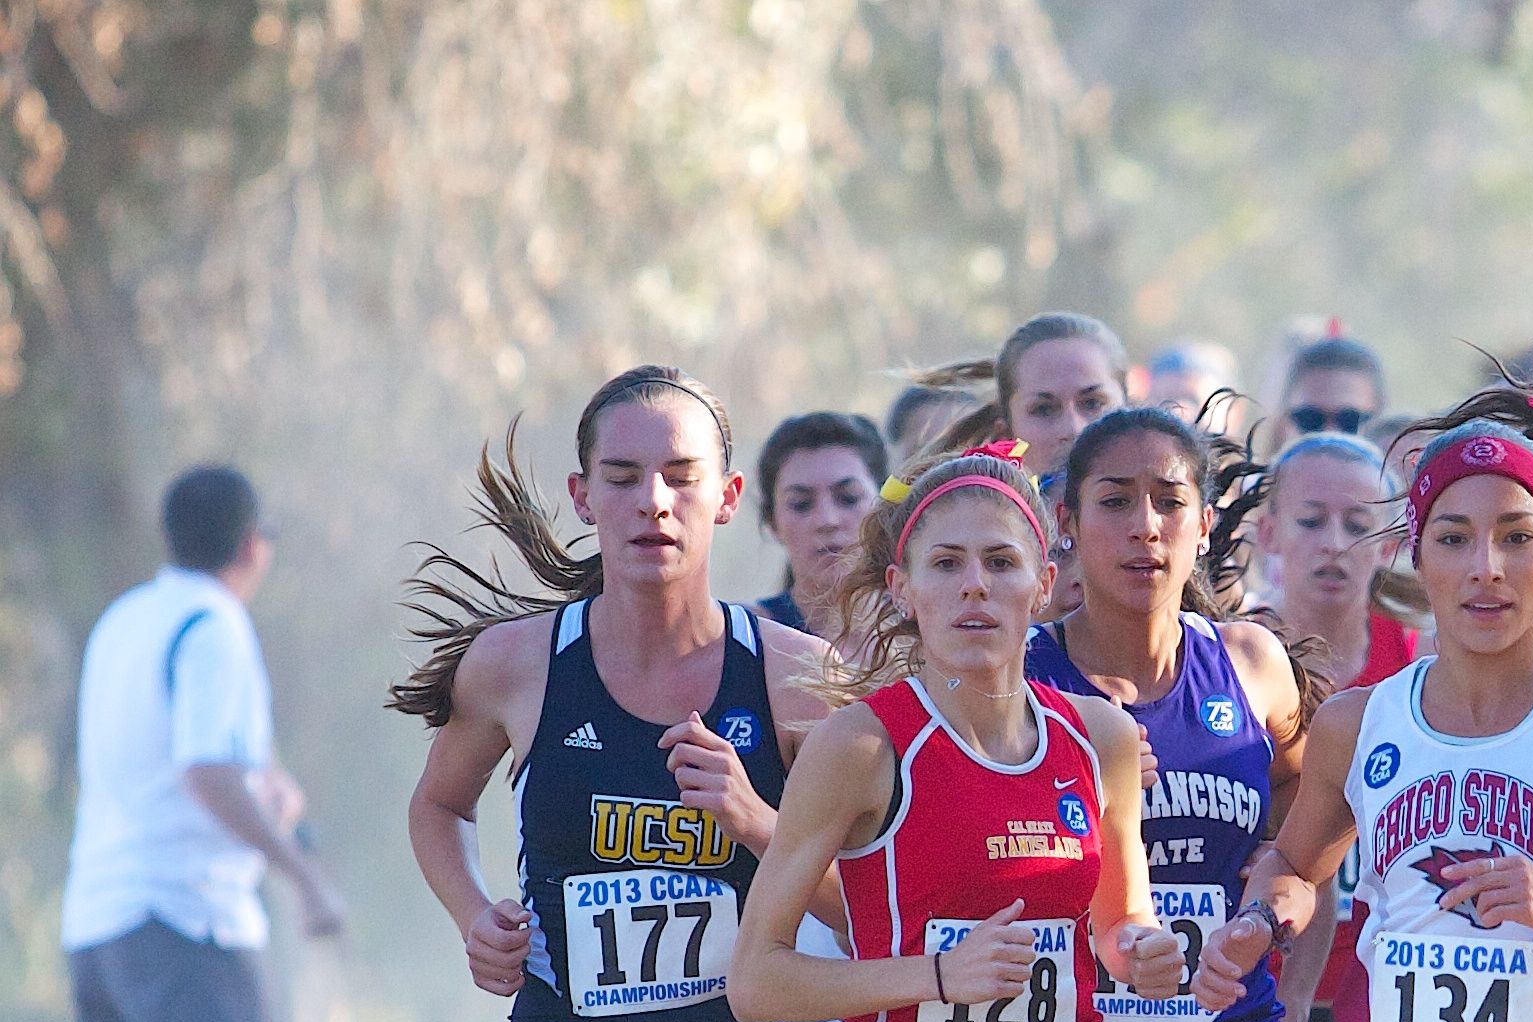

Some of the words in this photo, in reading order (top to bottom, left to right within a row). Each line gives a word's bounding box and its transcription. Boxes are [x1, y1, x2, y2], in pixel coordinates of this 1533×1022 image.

[1207, 702, 1234, 722] 75
[725, 716, 752, 738] 75
[563, 737, 603, 750] adidas
[1369, 748, 1393, 773] 75
[1062, 799, 1085, 821] 75
[1142, 770, 1262, 835] ANCISCO
[590, 794, 737, 870] UCSD
[1372, 769, 1457, 884] CHICO
[986, 834, 1084, 861] STANISLAUS
[1148, 837, 1205, 868] ATE
[577, 877, 642, 908] 2013
[650, 874, 724, 901] CCAA
[592, 901, 713, 987] 177
[1033, 926, 1067, 953] CAA
[1385, 939, 1445, 970] 2013
[1454, 945, 1528, 975] CCAA
[583, 975, 727, 1008] CHAMPIONSHIPS
[1096, 997, 1214, 1017] AMPIONSHI
